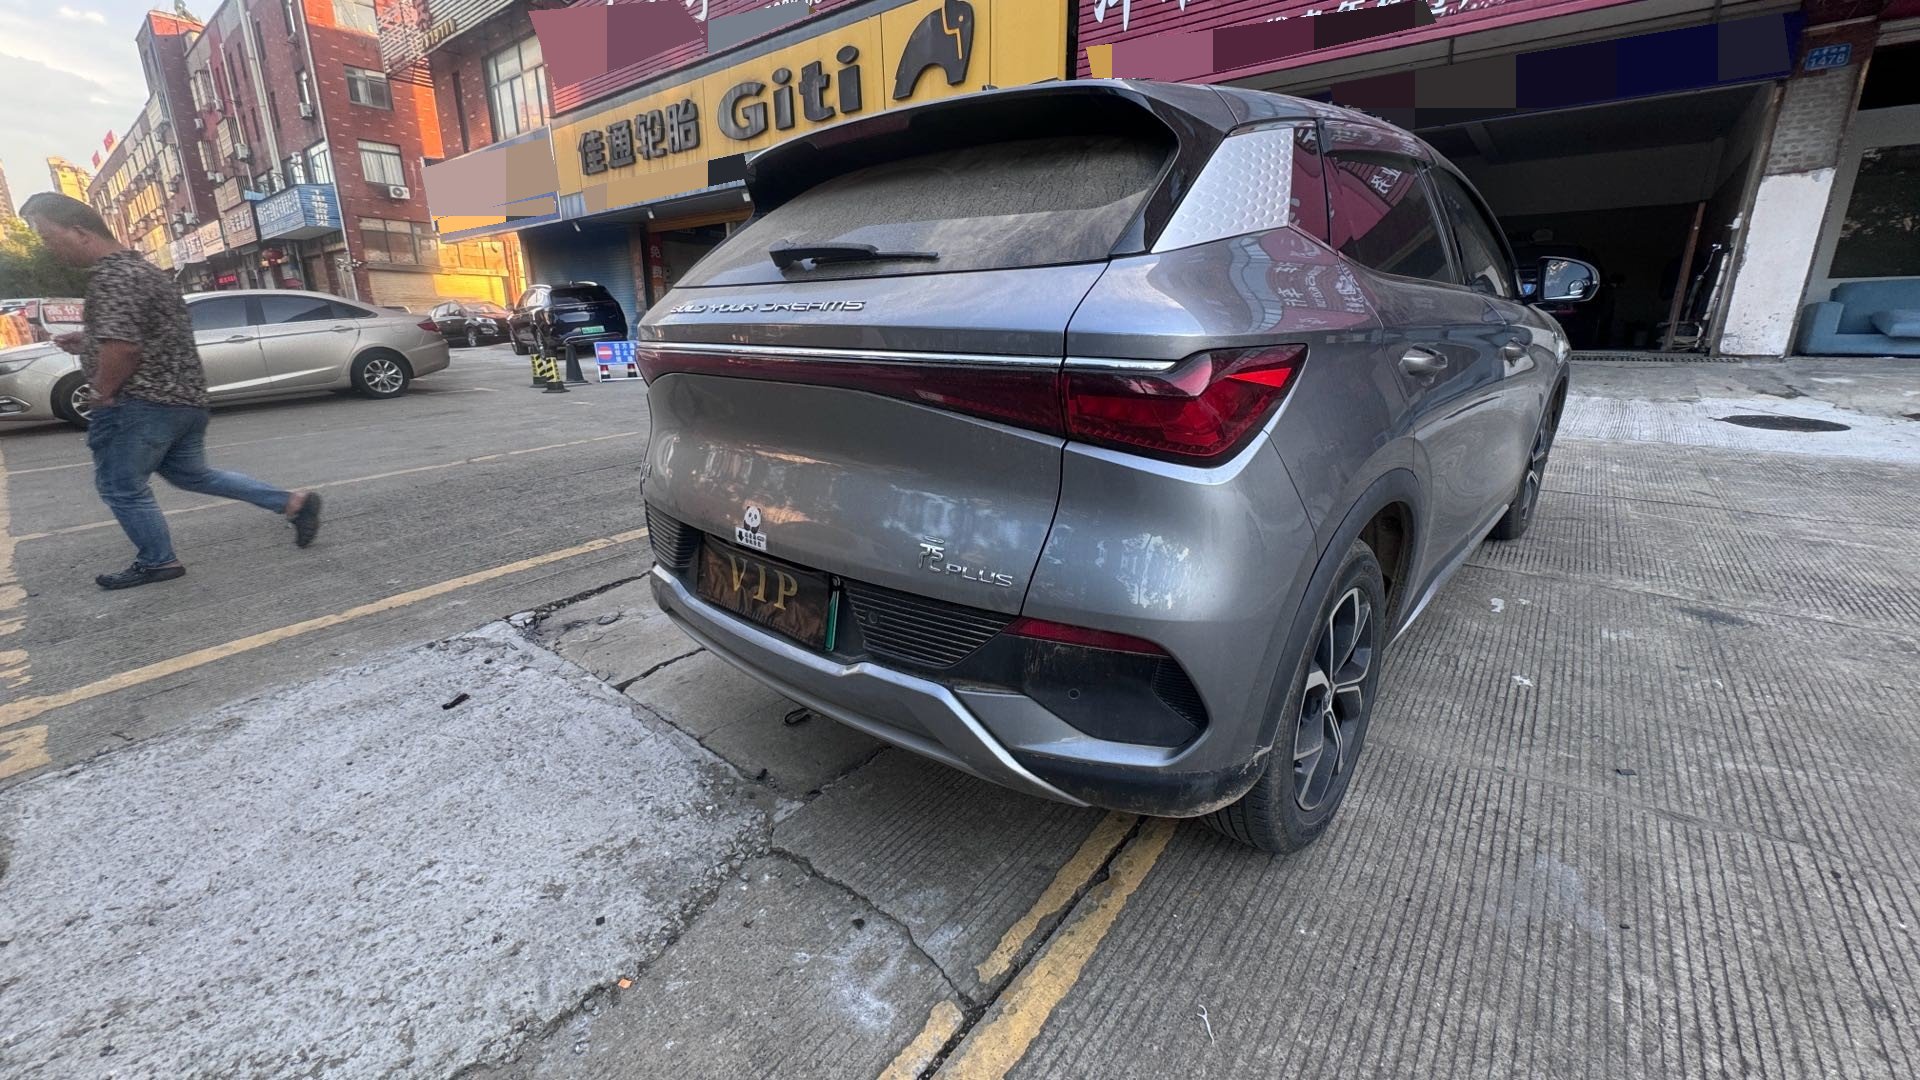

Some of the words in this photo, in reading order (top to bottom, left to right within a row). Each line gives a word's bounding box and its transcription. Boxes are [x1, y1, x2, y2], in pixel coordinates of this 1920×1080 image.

[717, 45, 863, 141] Giti
[577, 98, 701, 176] 佳通轮胎
[760, 299, 866, 313] DREAMS
[727, 552, 798, 611] VIP
[946, 563, 1013, 588] PLUS
